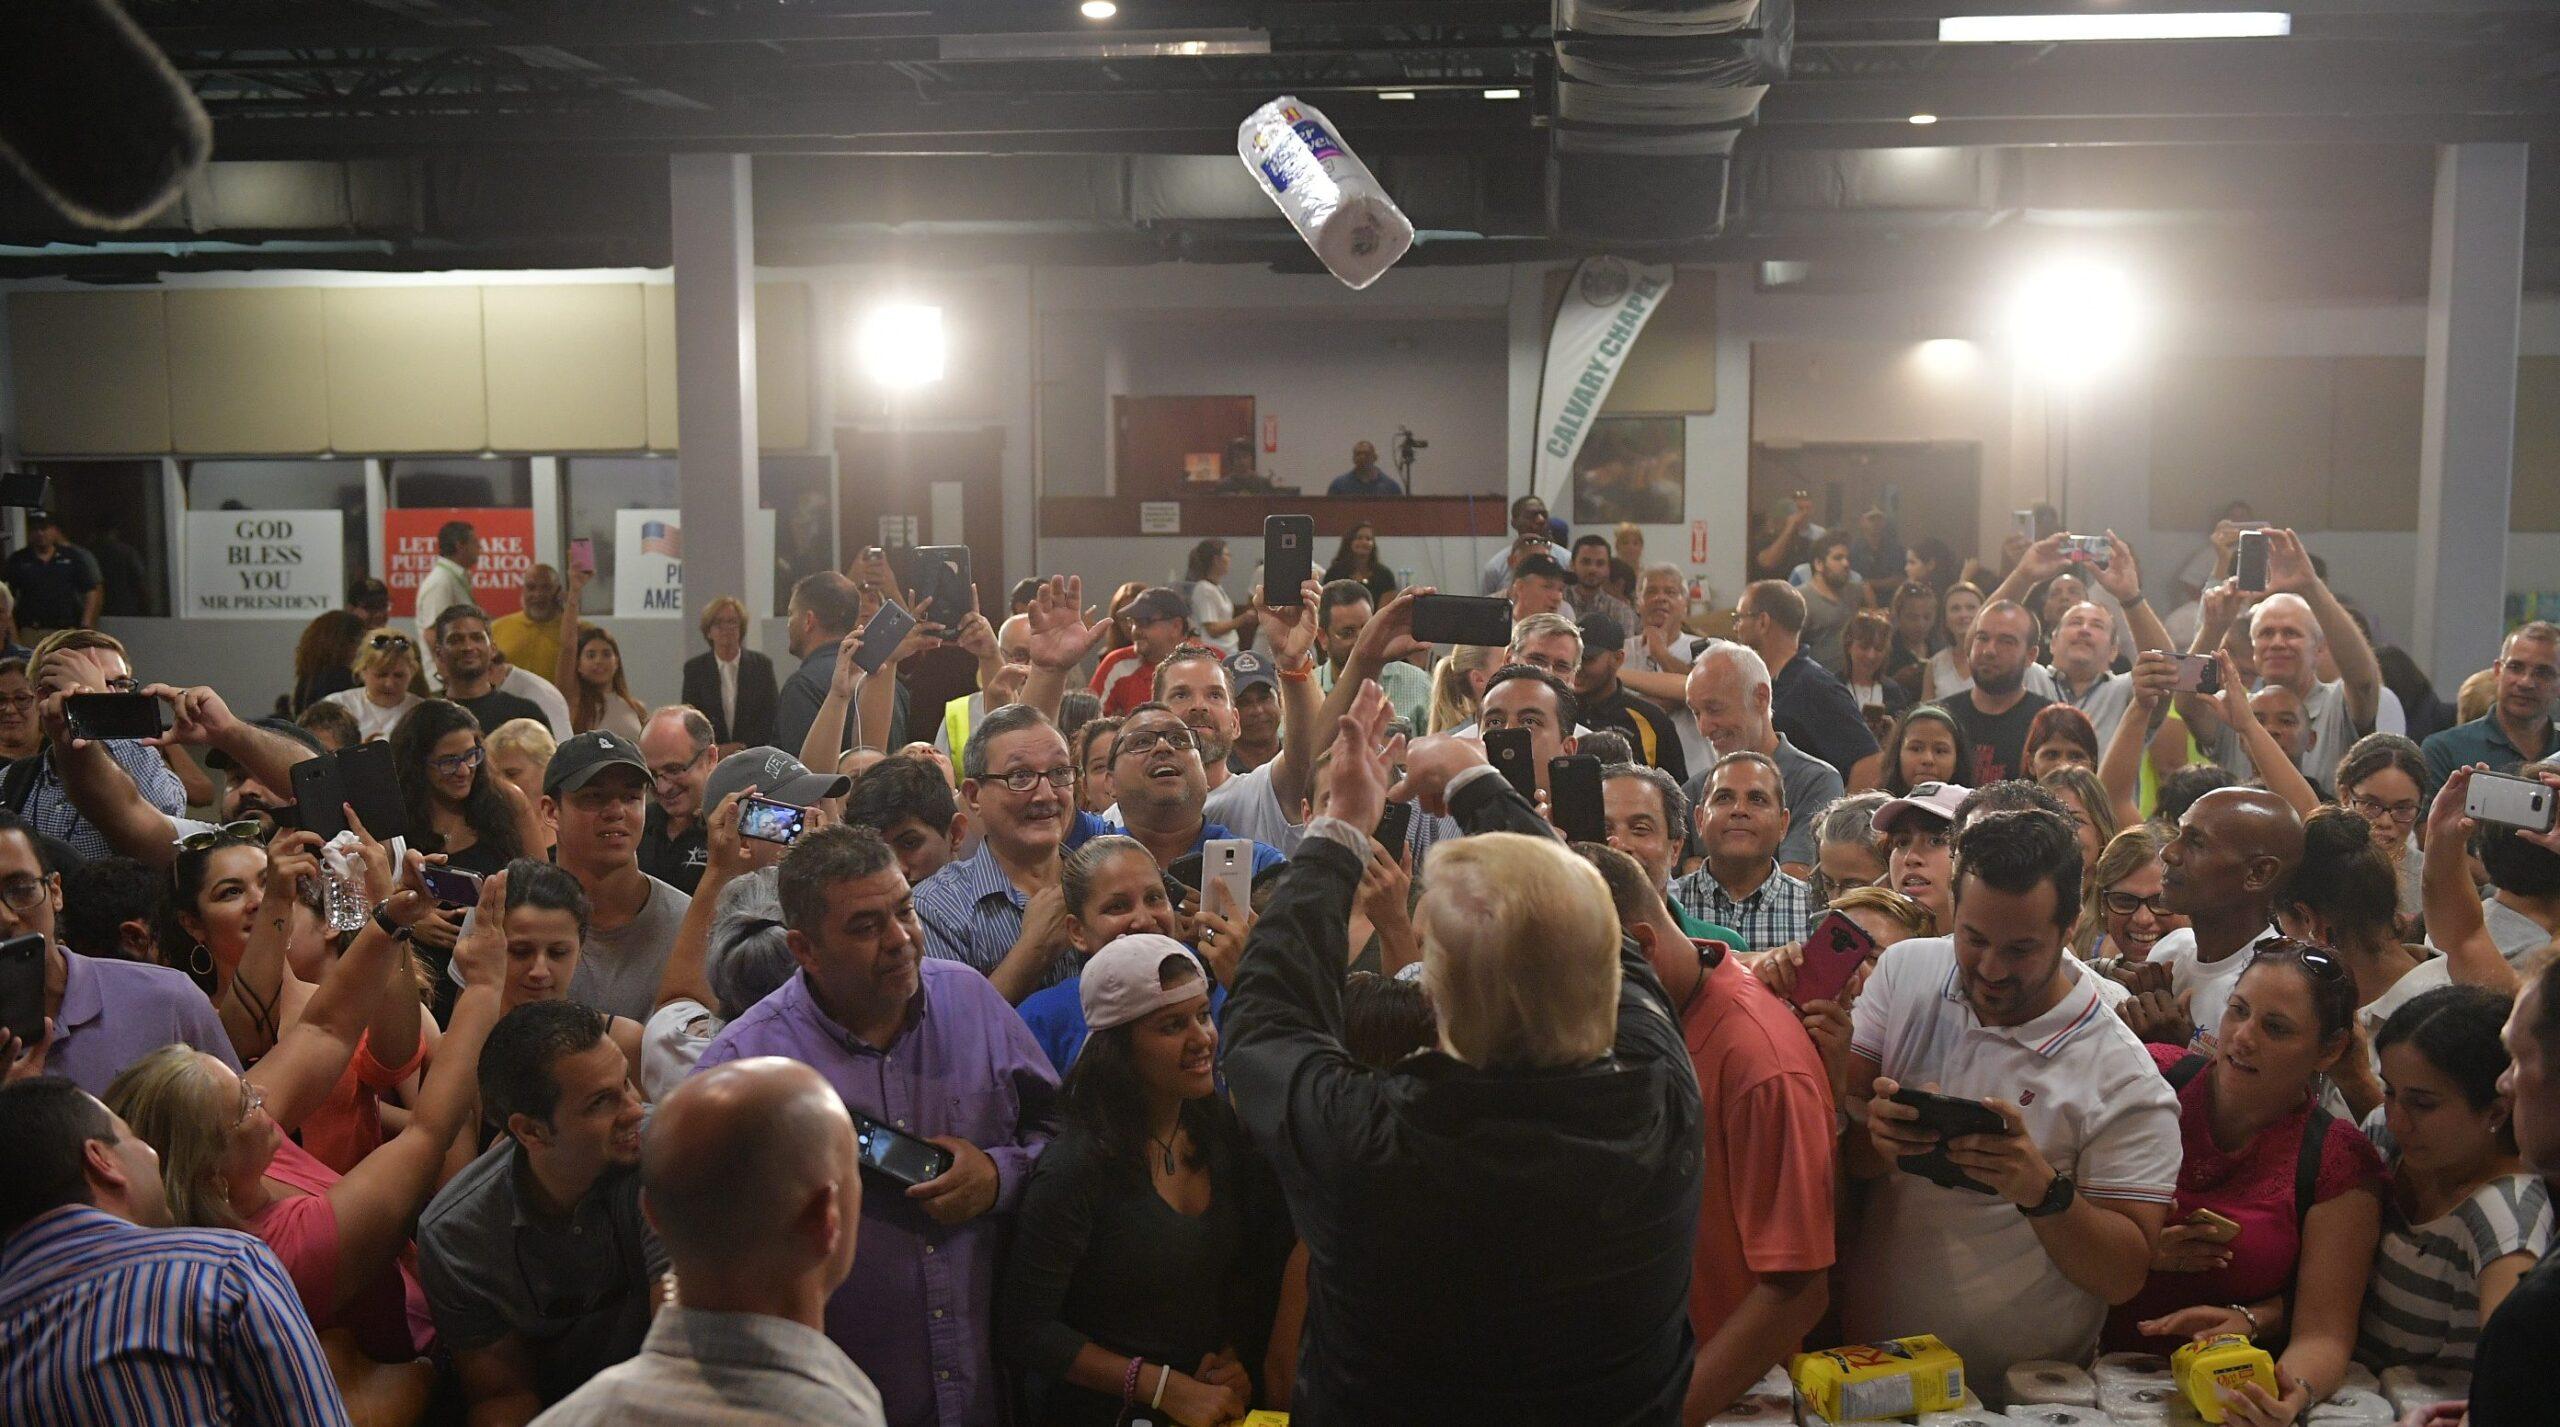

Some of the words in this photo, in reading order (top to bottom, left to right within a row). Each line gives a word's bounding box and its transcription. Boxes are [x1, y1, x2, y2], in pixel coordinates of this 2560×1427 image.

[1546, 355, 1611, 459] CALVARY
[1598, 275, 1665, 358] CHAPEL
[236, 520, 293, 539] GOD
[399, 536, 438, 553] LET
[479, 536, 523, 553] AKE
[228, 545, 302, 565] BLESS
[476, 554, 531, 571] RICO
[240, 571, 290, 590] YOU
[471, 572, 526, 588] GAIN
[232, 595, 329, 609] PRESIDENT
